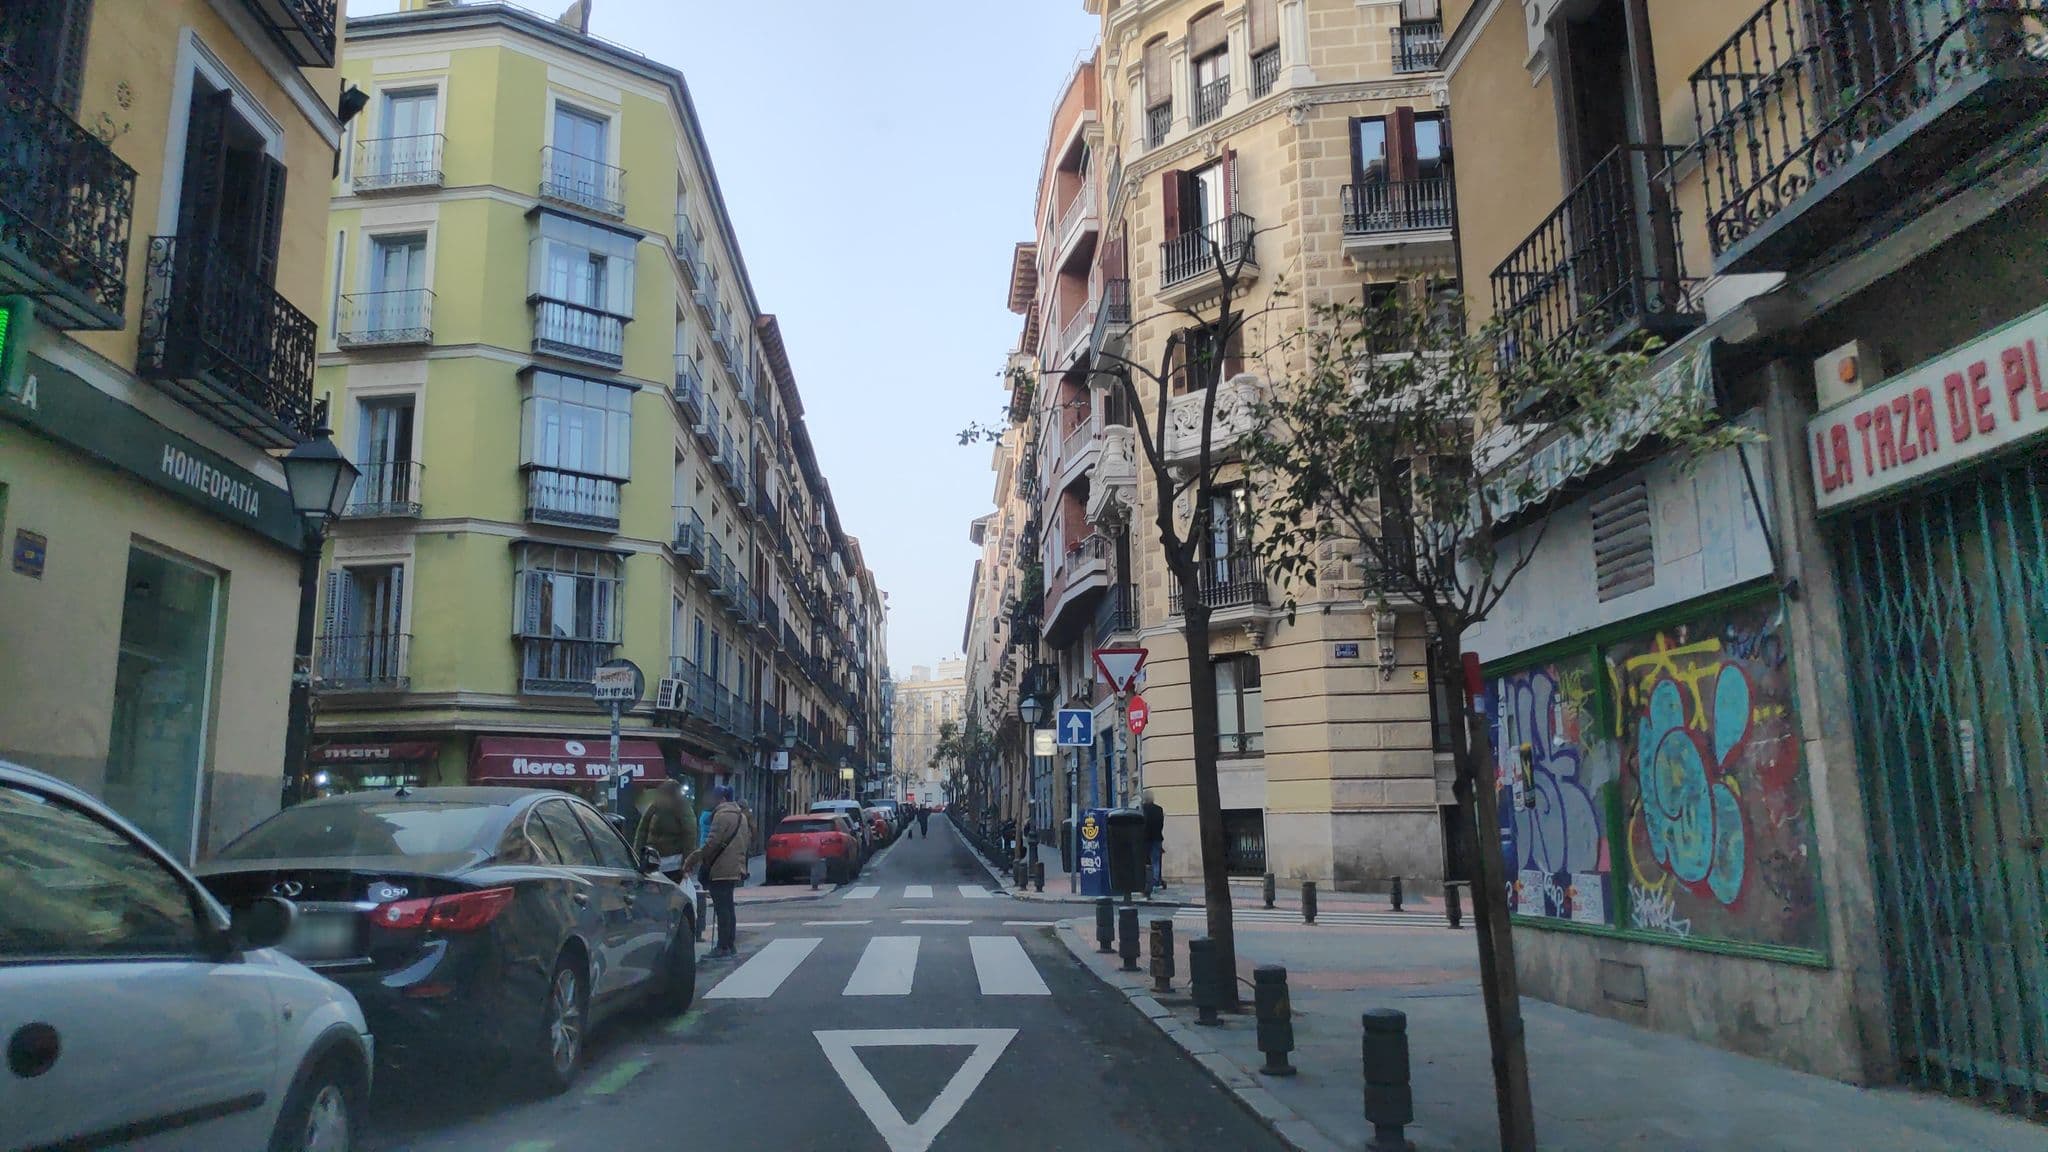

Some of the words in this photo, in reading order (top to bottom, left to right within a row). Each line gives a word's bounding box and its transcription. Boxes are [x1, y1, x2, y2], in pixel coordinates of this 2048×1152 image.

[1815, 423, 1853, 494] LA
[1854, 386, 1938, 477] TAZA
[1943, 359, 1996, 444] DE
[161, 444, 260, 518] HOMEOPATÍA
[324, 747, 390, 759] maru
[512, 758, 576, 775] flores
[380, 887, 409, 898] Q50
